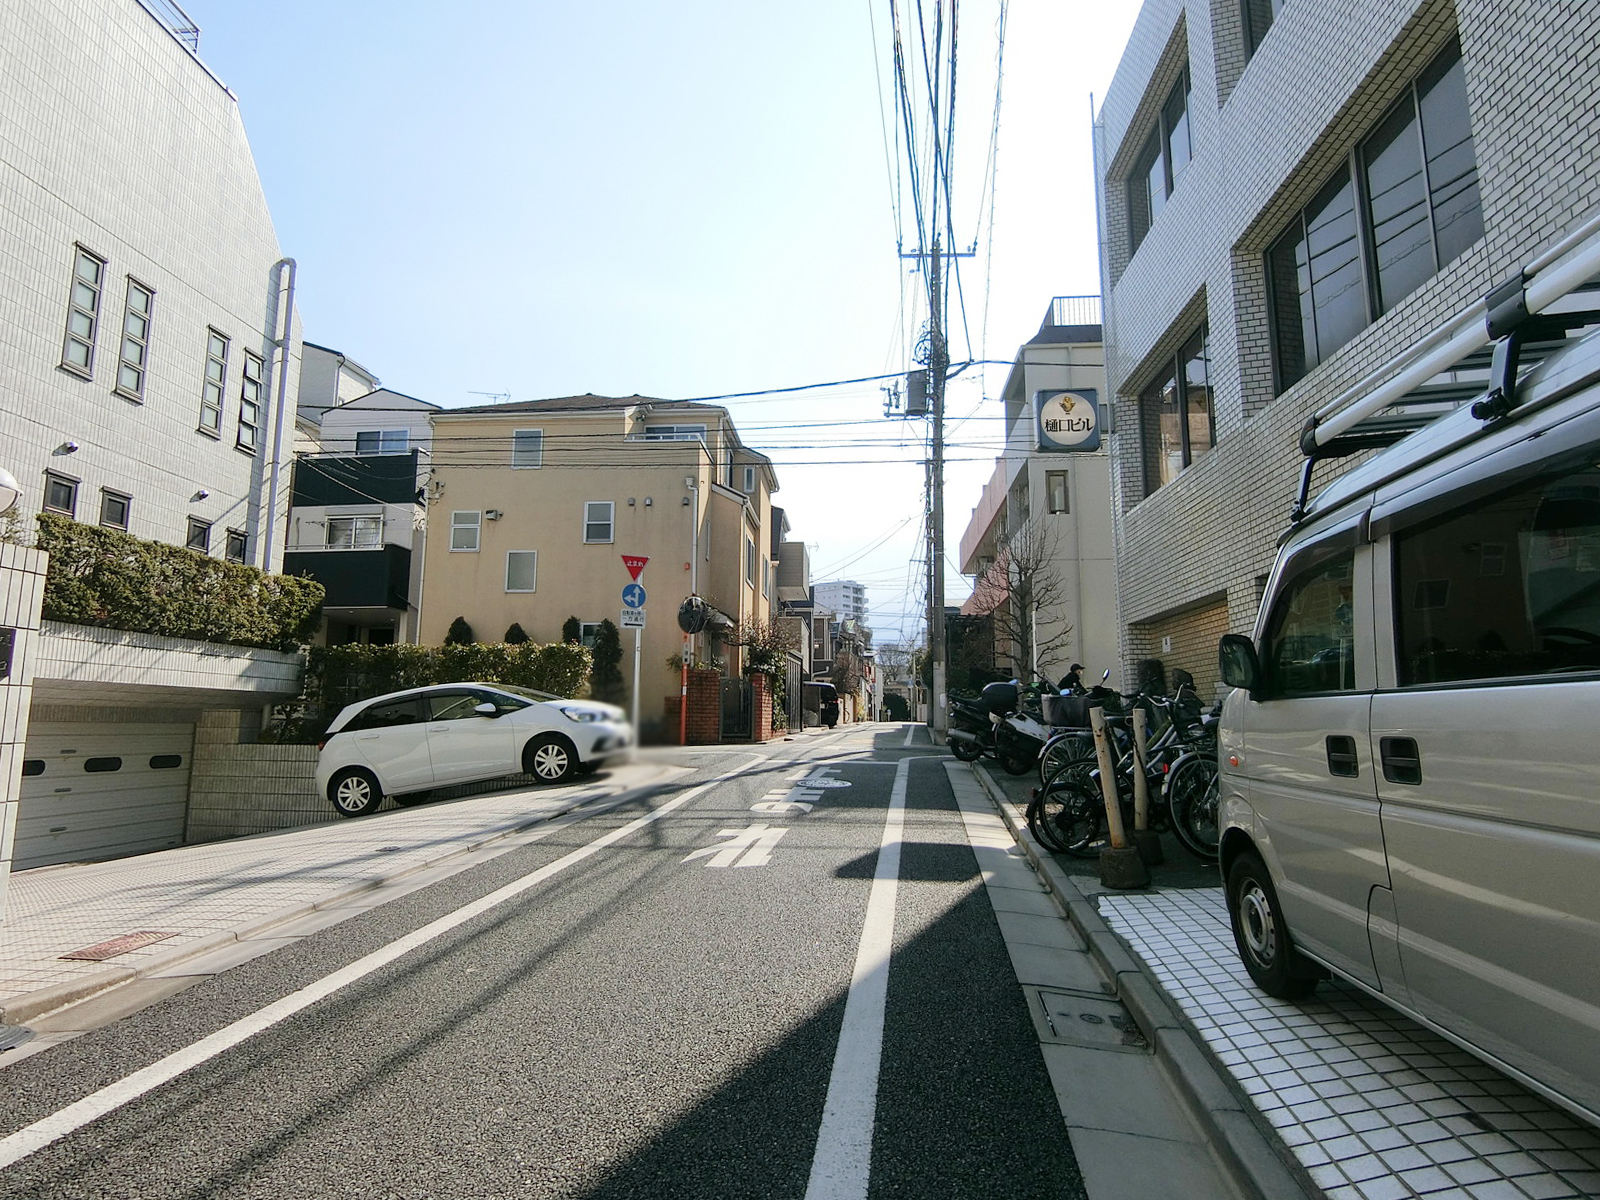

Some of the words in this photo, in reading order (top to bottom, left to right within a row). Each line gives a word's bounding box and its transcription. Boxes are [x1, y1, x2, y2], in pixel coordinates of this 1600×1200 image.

[1044, 417, 1094, 432] 樋口ビル
[679, 766, 843, 868] 止まれ
